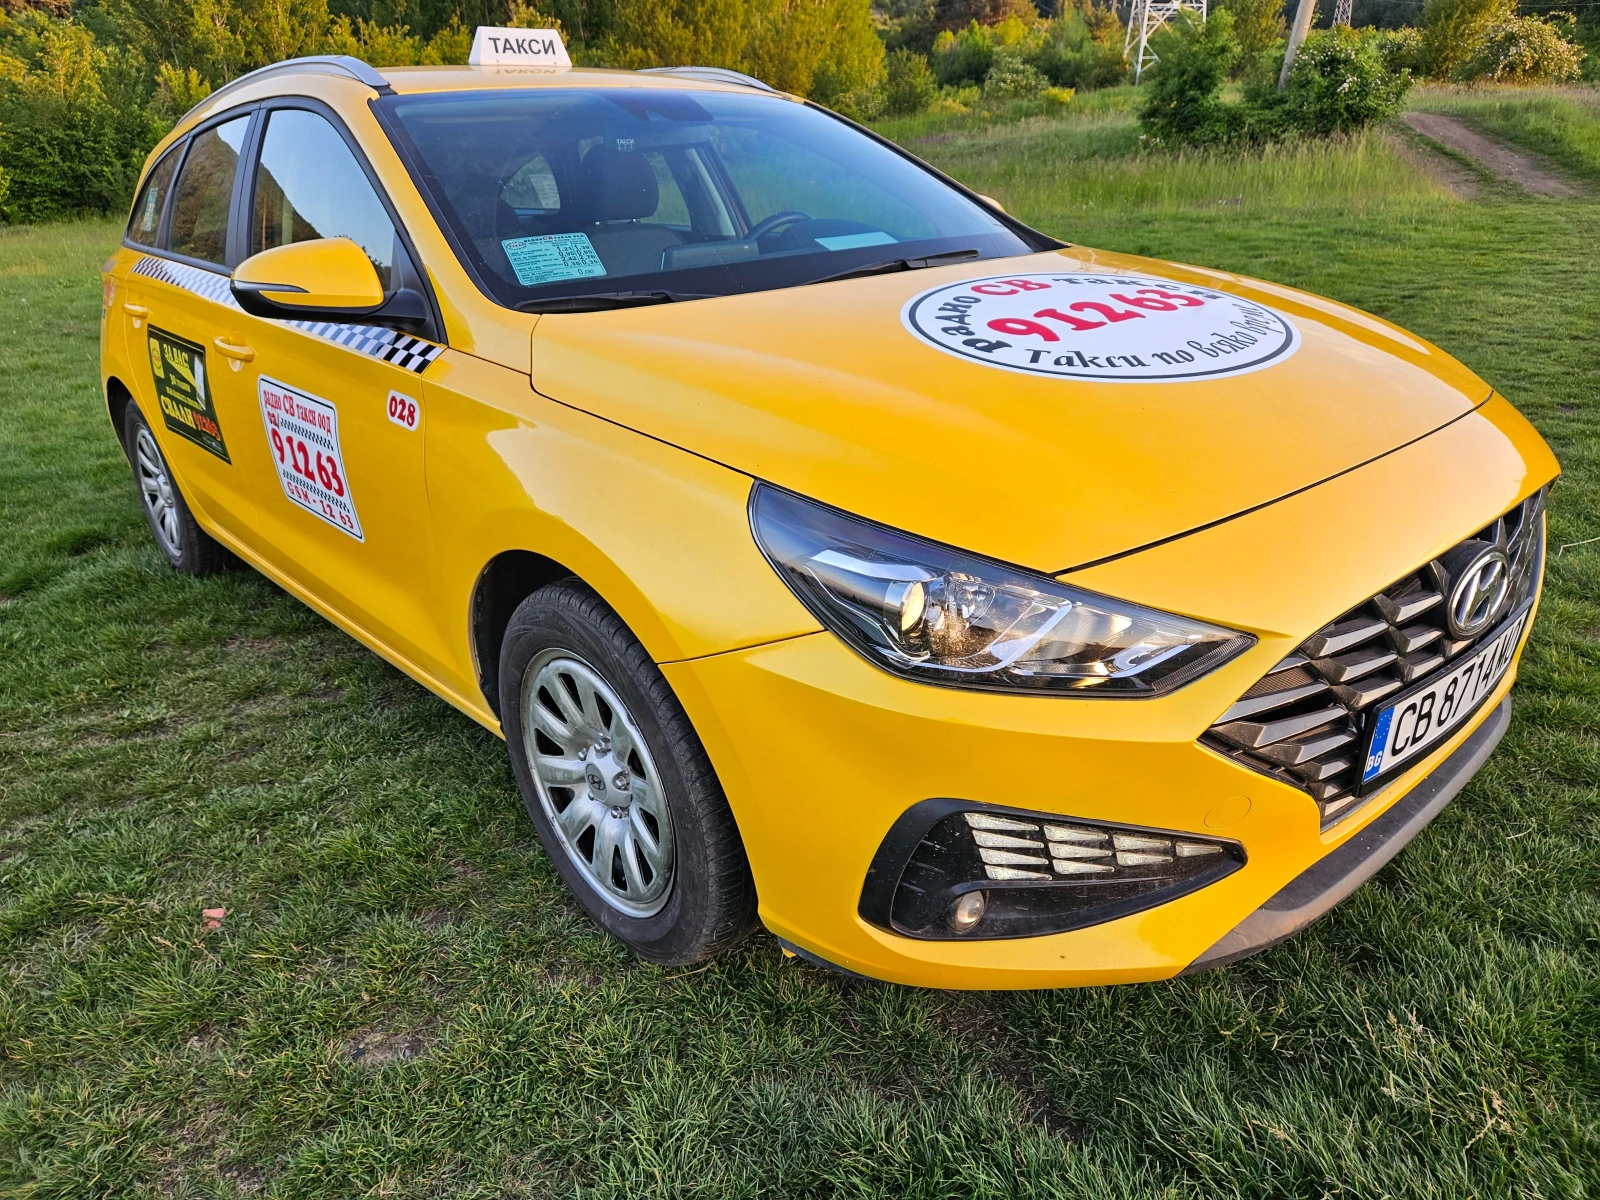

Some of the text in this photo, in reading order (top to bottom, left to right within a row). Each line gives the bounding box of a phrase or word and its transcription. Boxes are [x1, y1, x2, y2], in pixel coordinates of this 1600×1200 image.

[488, 37, 556, 55] ТАКСИ
[970, 279, 1052, 296] СВ
[1024, 348, 1152, 368] Такси
[1151, 349, 1196, 365] по
[283, 394, 295, 417] СВ
[388, 395, 416, 427] 028
[287, 481, 312, 504] GSM
[1391, 690, 1437, 757] CB
[1365, 750, 1383, 773] BG
